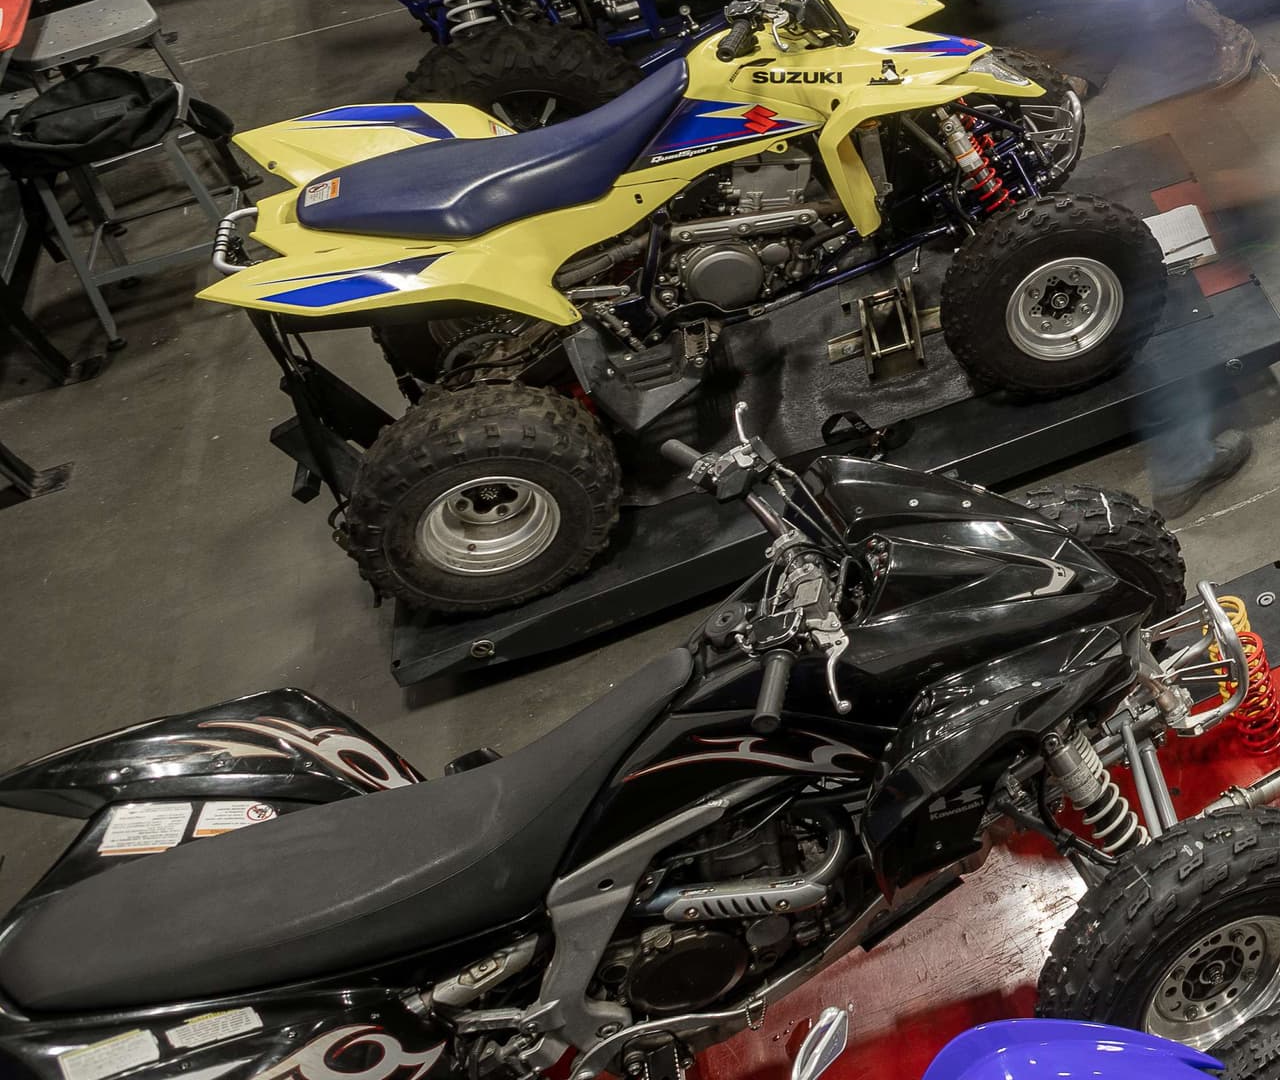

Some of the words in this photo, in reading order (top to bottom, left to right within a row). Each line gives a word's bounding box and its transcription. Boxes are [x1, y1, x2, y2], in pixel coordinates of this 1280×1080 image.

[752, 71, 843, 85] SUZUKI
[650, 145, 719, 164] QuadSport
[929, 798, 985, 821] Kawasaki
